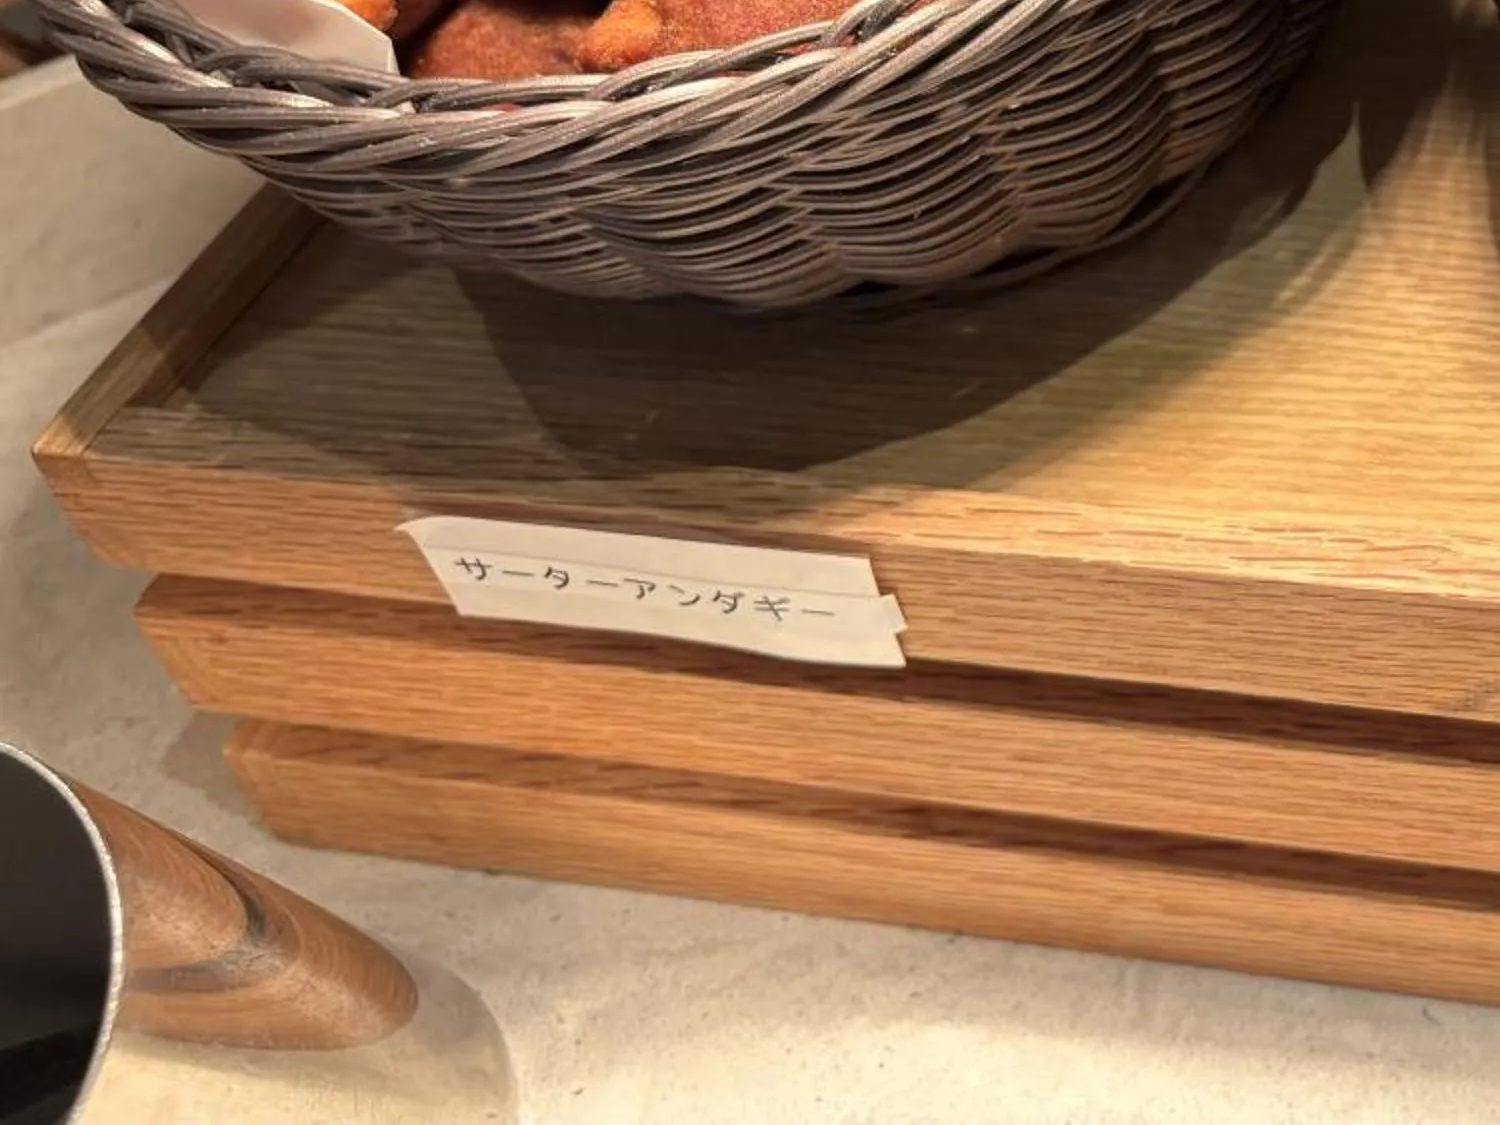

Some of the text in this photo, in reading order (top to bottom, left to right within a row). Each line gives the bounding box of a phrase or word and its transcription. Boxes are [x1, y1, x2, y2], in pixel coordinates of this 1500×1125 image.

[454, 557, 836, 622] サーターアンダギー
